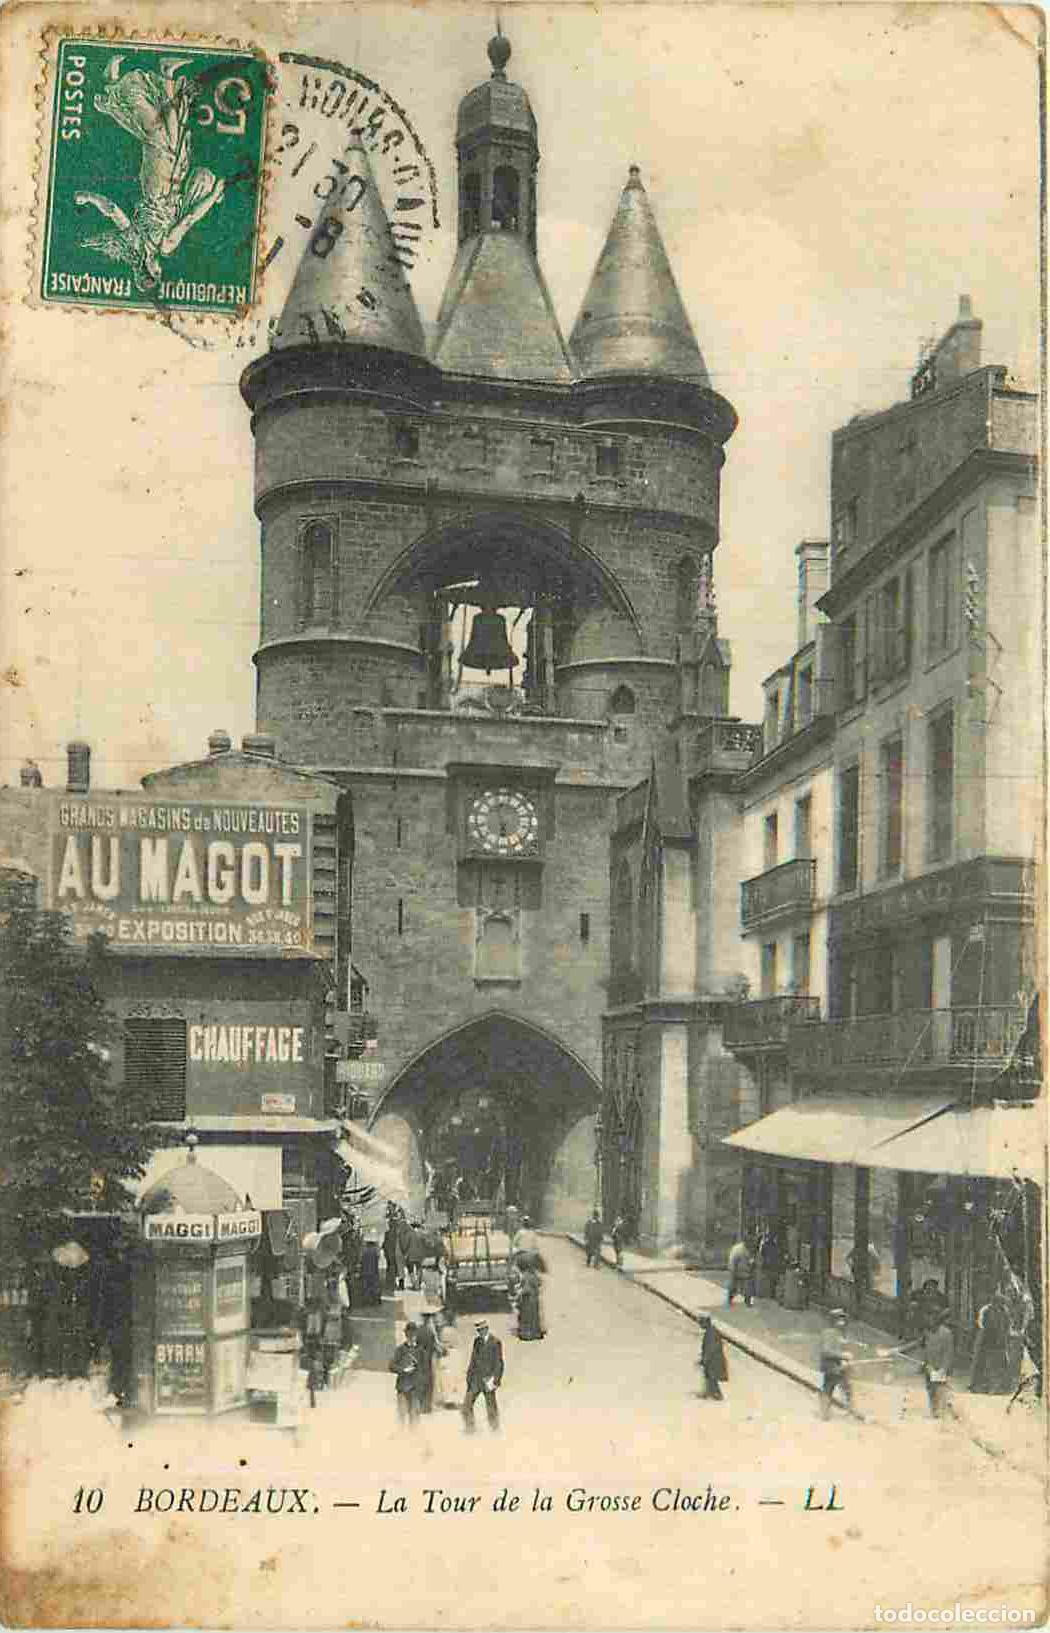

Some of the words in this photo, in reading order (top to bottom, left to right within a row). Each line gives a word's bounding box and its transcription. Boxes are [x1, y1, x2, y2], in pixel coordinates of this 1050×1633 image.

[61, 55, 87, 141] POSTES
[50, 271, 132, 298] FRANÇAISE
[59, 802, 115, 828] GRANDS
[119, 805, 191, 831] MAGASINS
[57, 834, 122, 902] AU
[139, 836, 303, 908] MAGOT
[117, 918, 243, 944] EXPOSITION
[189, 1025, 304, 1063] CHAUFFAGE
[150, 1222, 211, 1238] MAGGI
[220, 1217, 261, 1235] MAGGI
